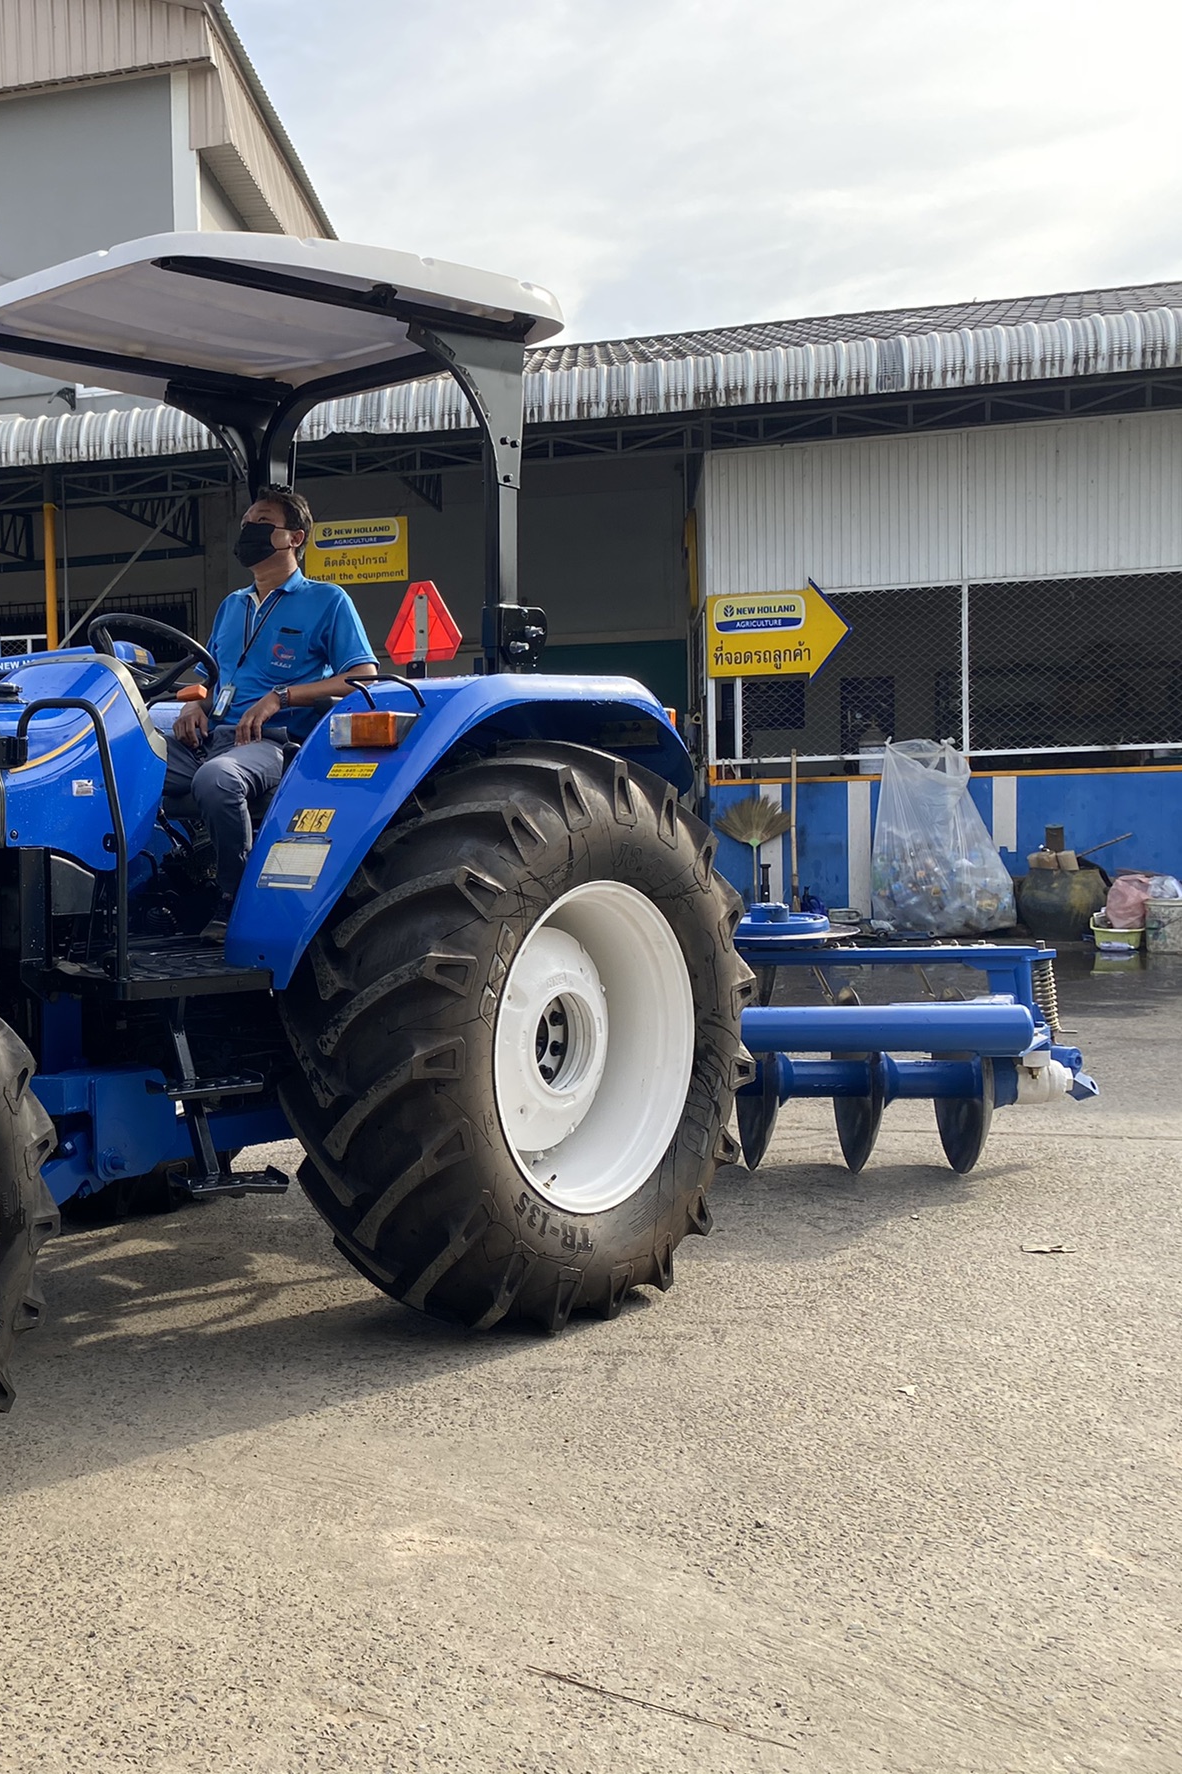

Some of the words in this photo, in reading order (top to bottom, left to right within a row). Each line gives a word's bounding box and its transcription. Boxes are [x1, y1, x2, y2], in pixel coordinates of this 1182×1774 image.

[334, 527, 352, 536] NEW
[353, 525, 390, 534] HOLLAND
[333, 536, 377, 545] AGRICULTURE
[324, 552, 388, 569] ติดตั้งอุปกรณ์
[339, 572, 354, 580] the
[357, 569, 404, 580] equipment
[736, 607, 755, 615] NEW
[757, 604, 796, 614] HOLLAND
[735, 619, 782, 628] AGRICULTURE
[713, 640, 811, 669] ที่จอดรถลูกค้า
[513, 1191, 594, 1255] TR-135
